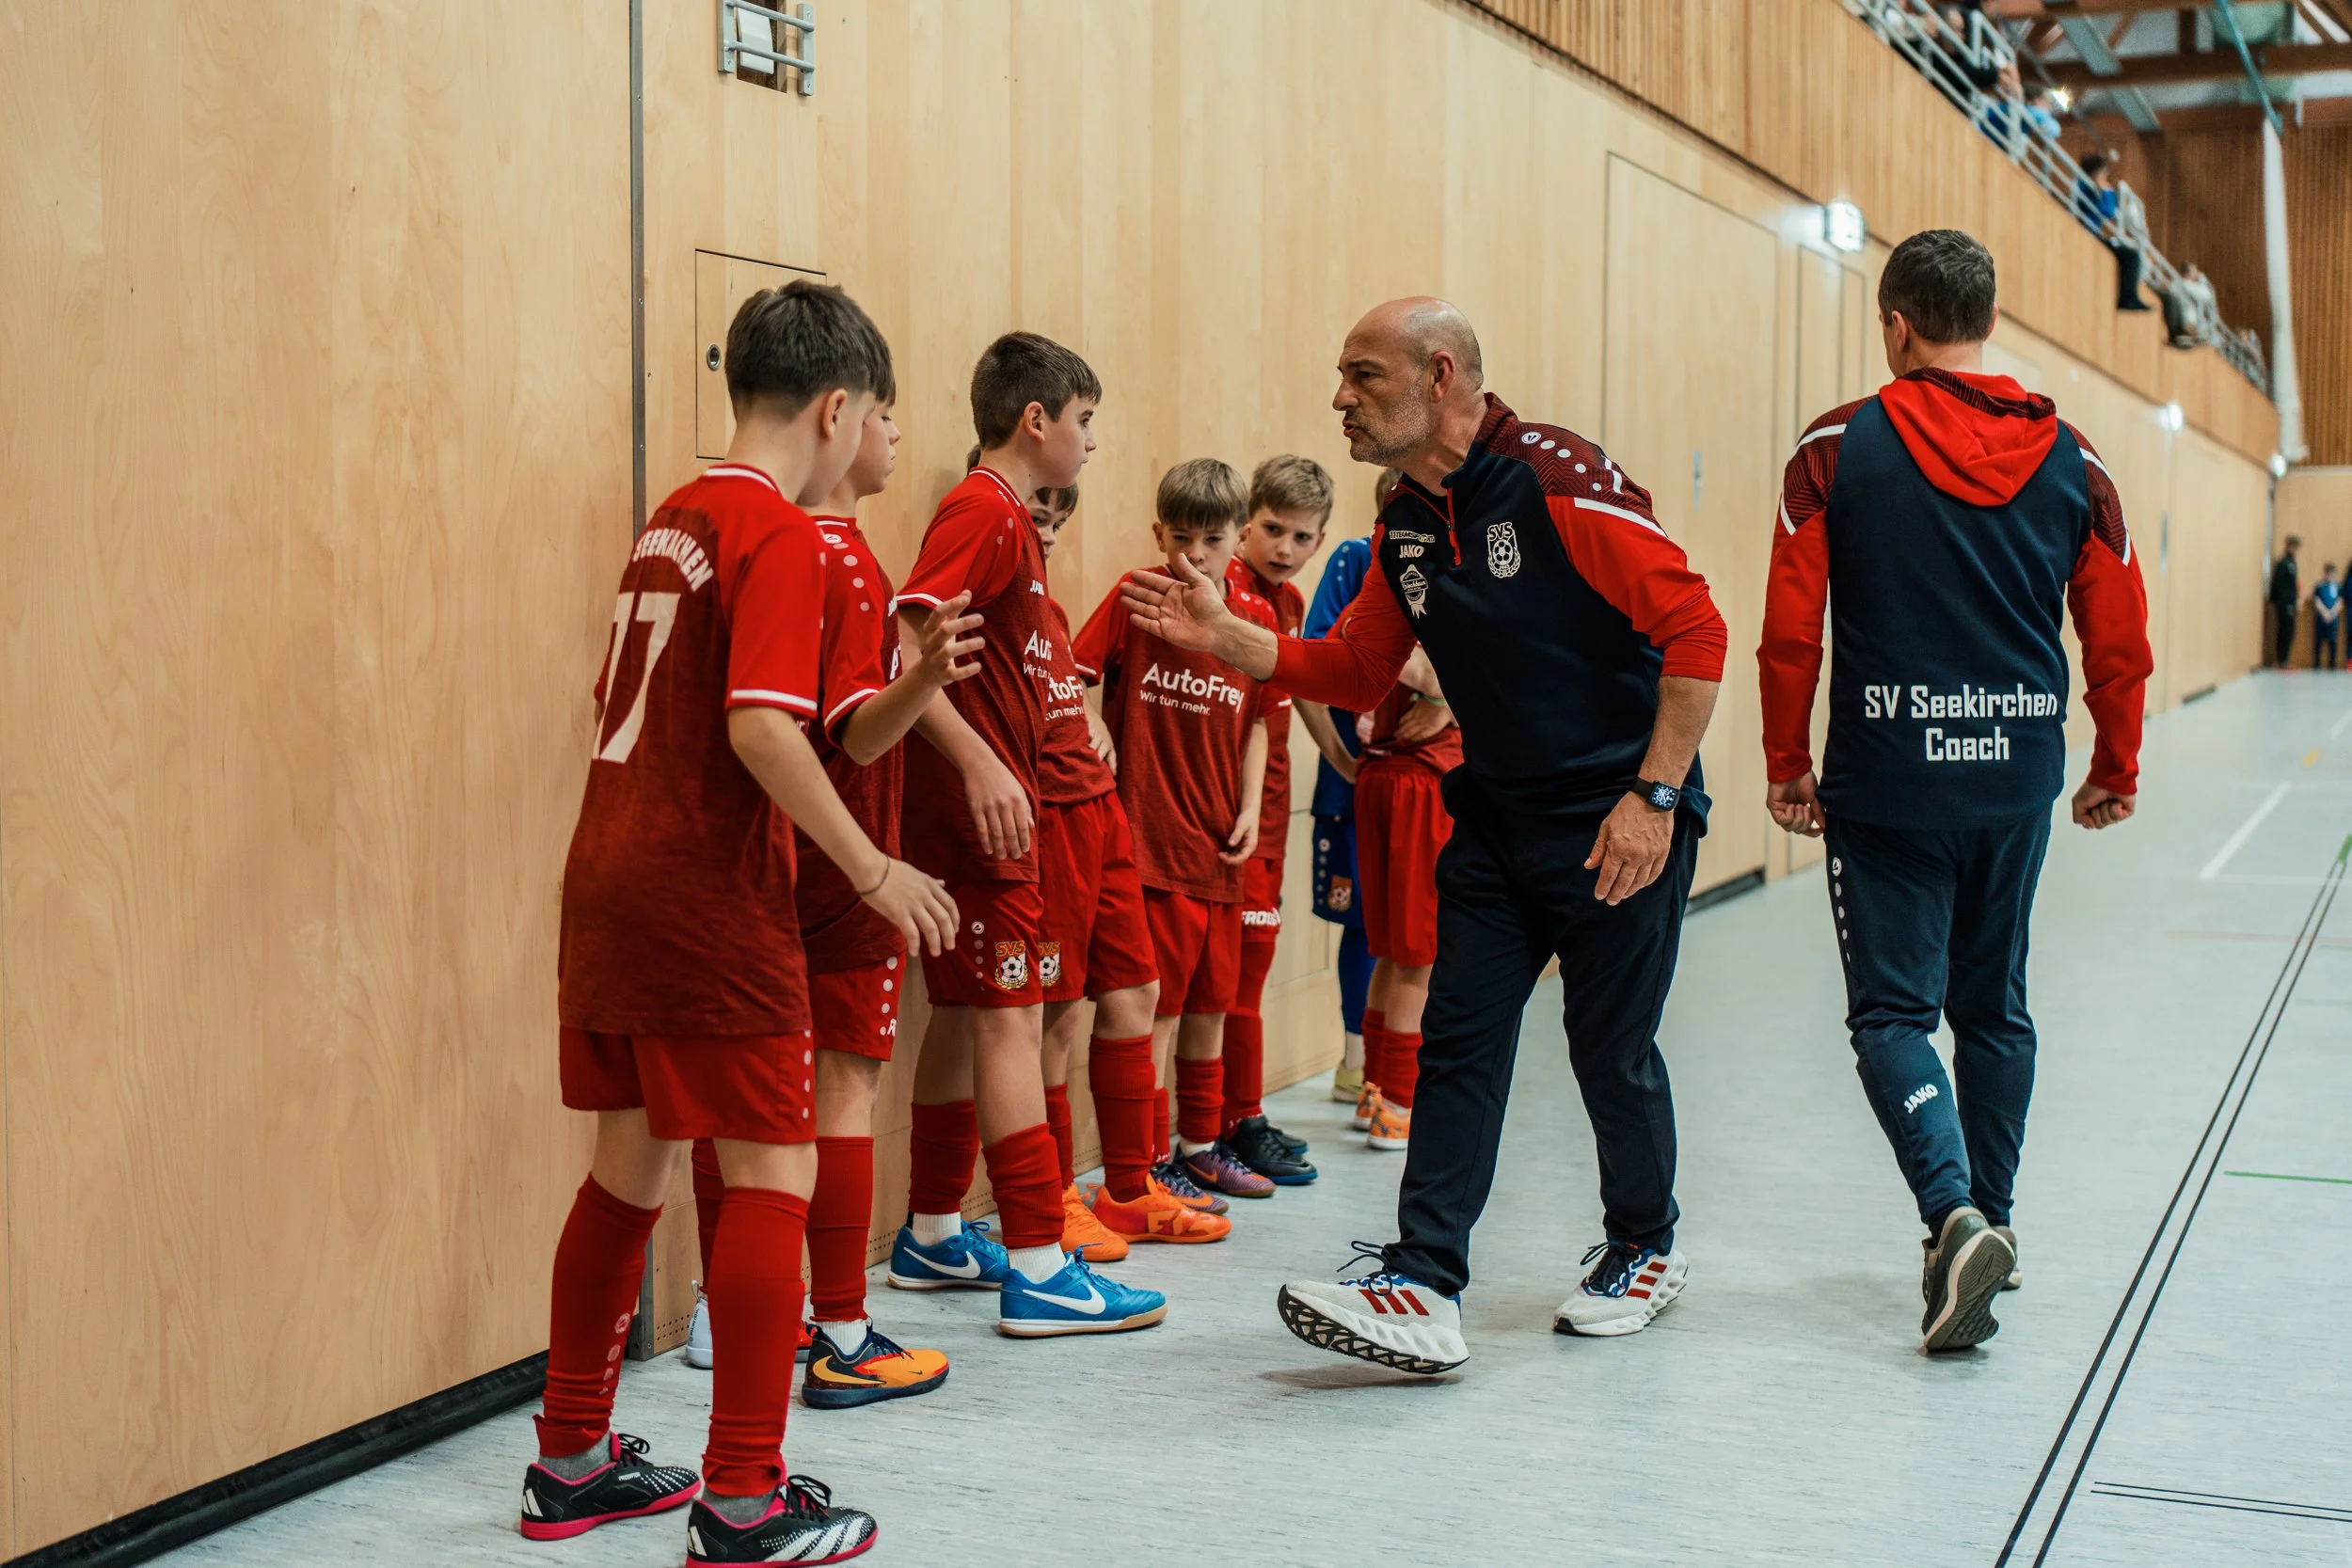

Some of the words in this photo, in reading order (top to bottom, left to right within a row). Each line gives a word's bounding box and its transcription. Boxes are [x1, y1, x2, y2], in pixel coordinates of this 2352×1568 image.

[1487, 522, 1514, 541] SVS
[1399, 545, 1424, 559] JAKO
[593, 592, 681, 764] 17
[1141, 662, 1245, 714] AutoFrey
[1140, 689, 1158, 704] Wir
[1159, 694, 1179, 708] tun
[1865, 685, 1900, 719] SV
[1911, 683, 2058, 719] Seekirchen
[1926, 726, 2010, 761] Coach
[995, 941, 1025, 957] SVS
[1904, 1084, 1938, 1114] JAKO
